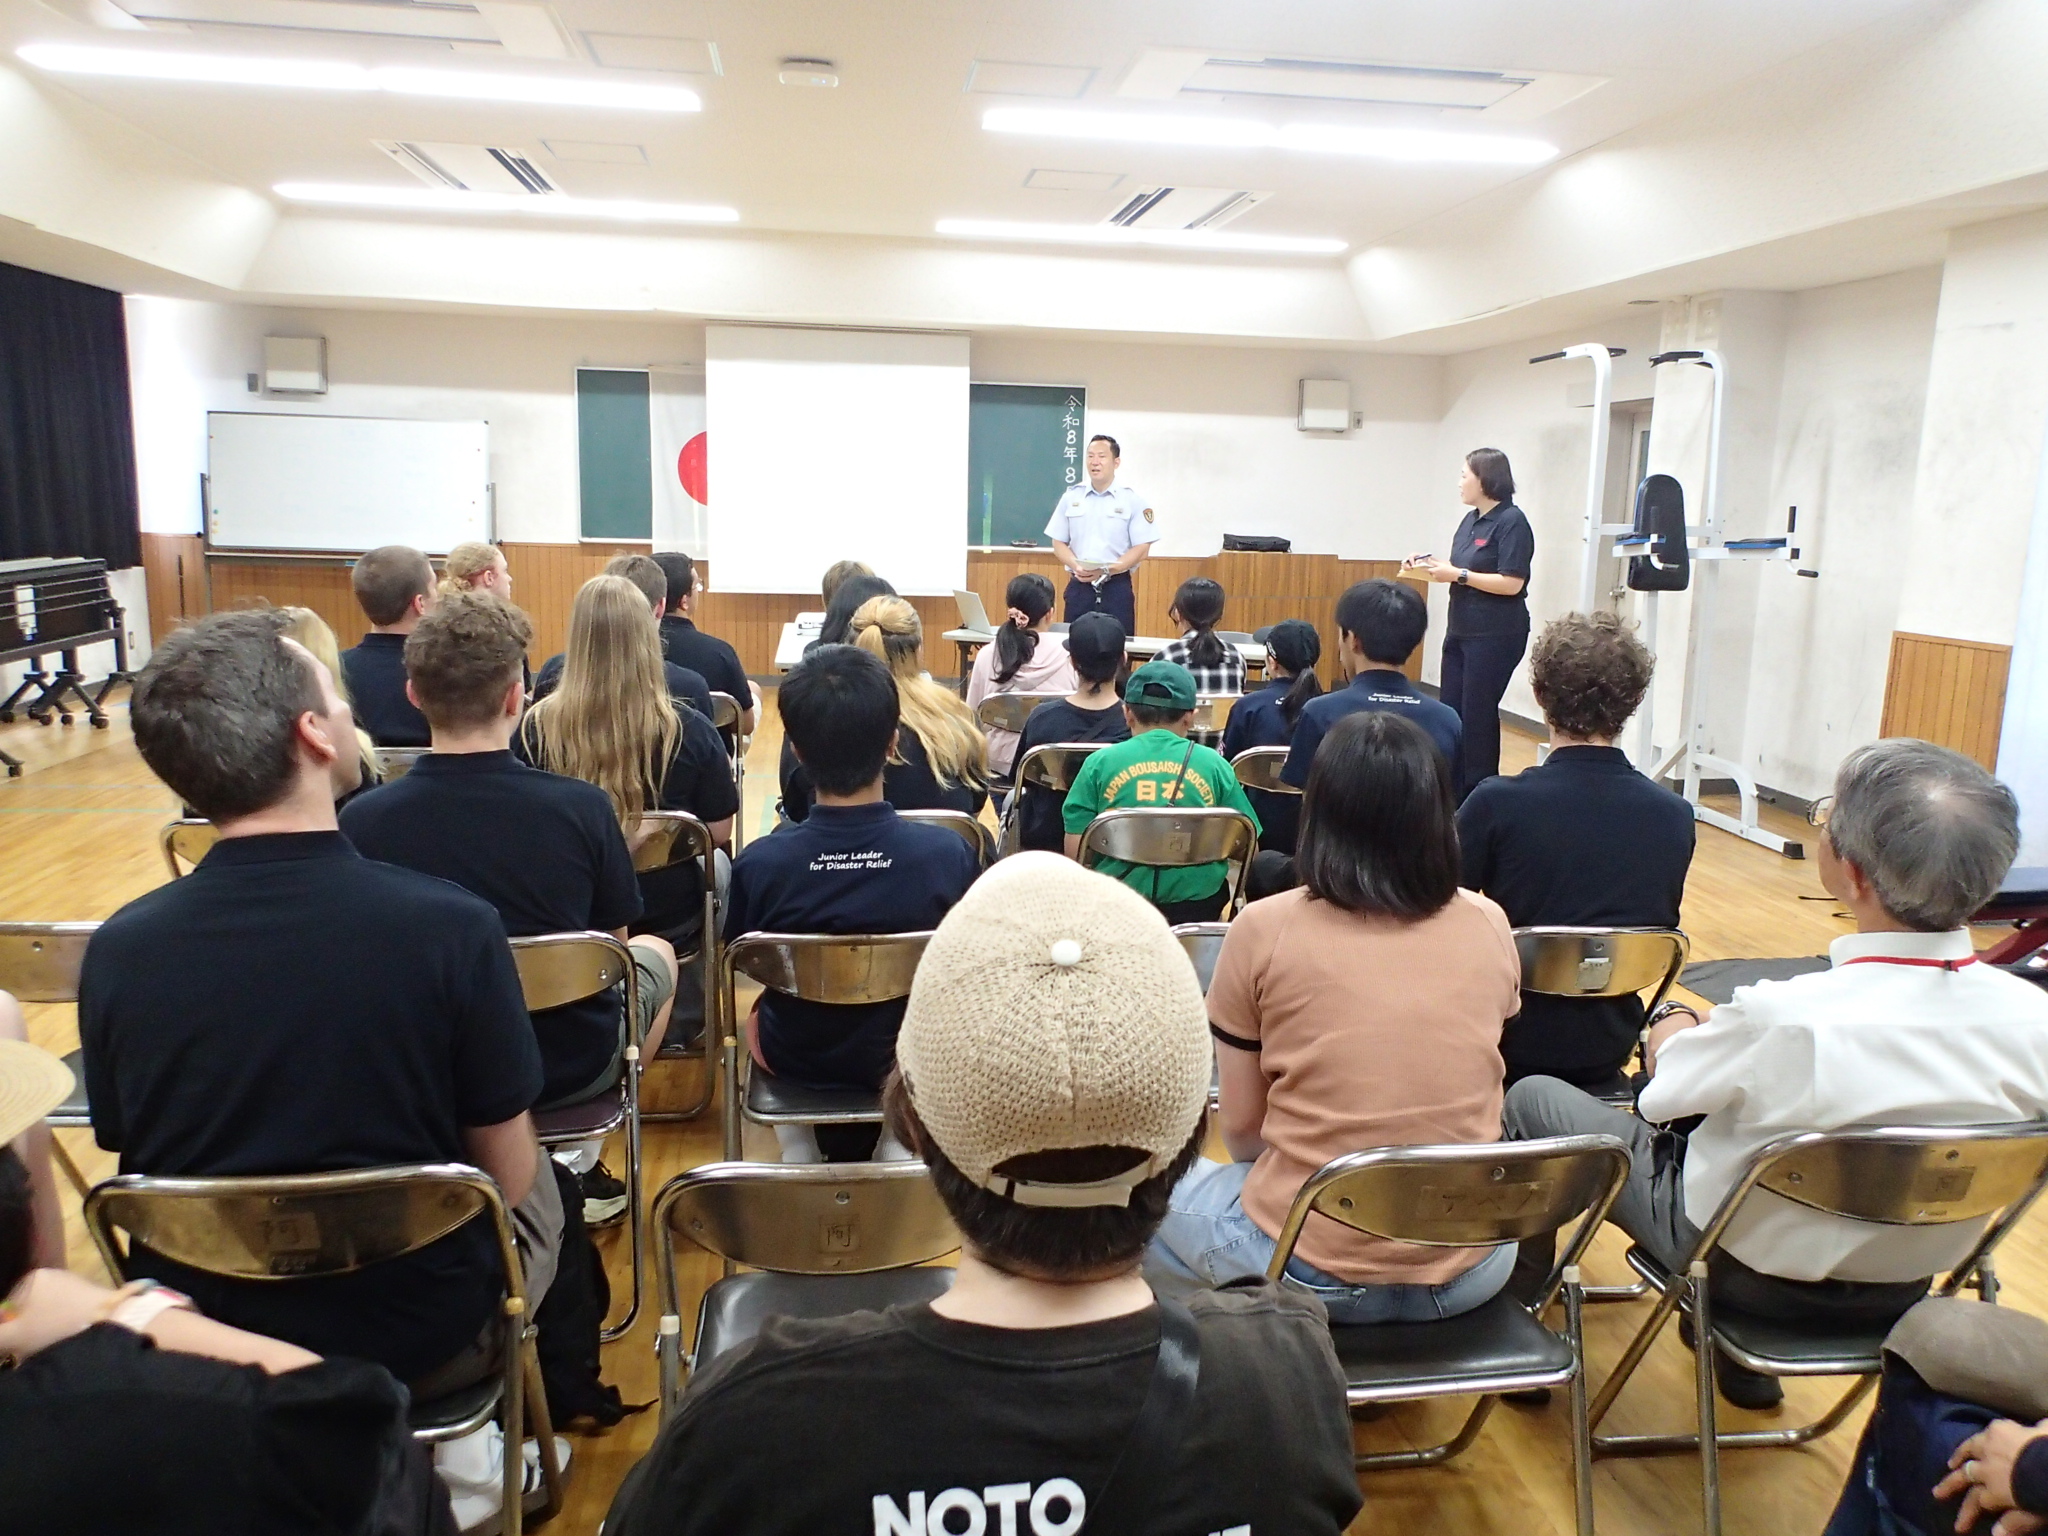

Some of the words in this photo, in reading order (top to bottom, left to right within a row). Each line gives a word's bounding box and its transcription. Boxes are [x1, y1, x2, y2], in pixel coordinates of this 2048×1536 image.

[1062, 395, 1082, 490] 令和8年8
[1103, 770, 1131, 804] JAPAN
[1128, 761, 1183, 777] BOUSAISH
[1184, 768, 1214, 807] SOCIETY
[1136, 780, 1185, 801] 日本
[809, 861, 824, 871] for
[826, 861, 864, 870] Disaster
[866, 859, 892, 869] Relief
[818, 852, 849, 861] Junior
[851, 851, 883, 860] Leader
[872, 1477, 1086, 1536] NOTO
